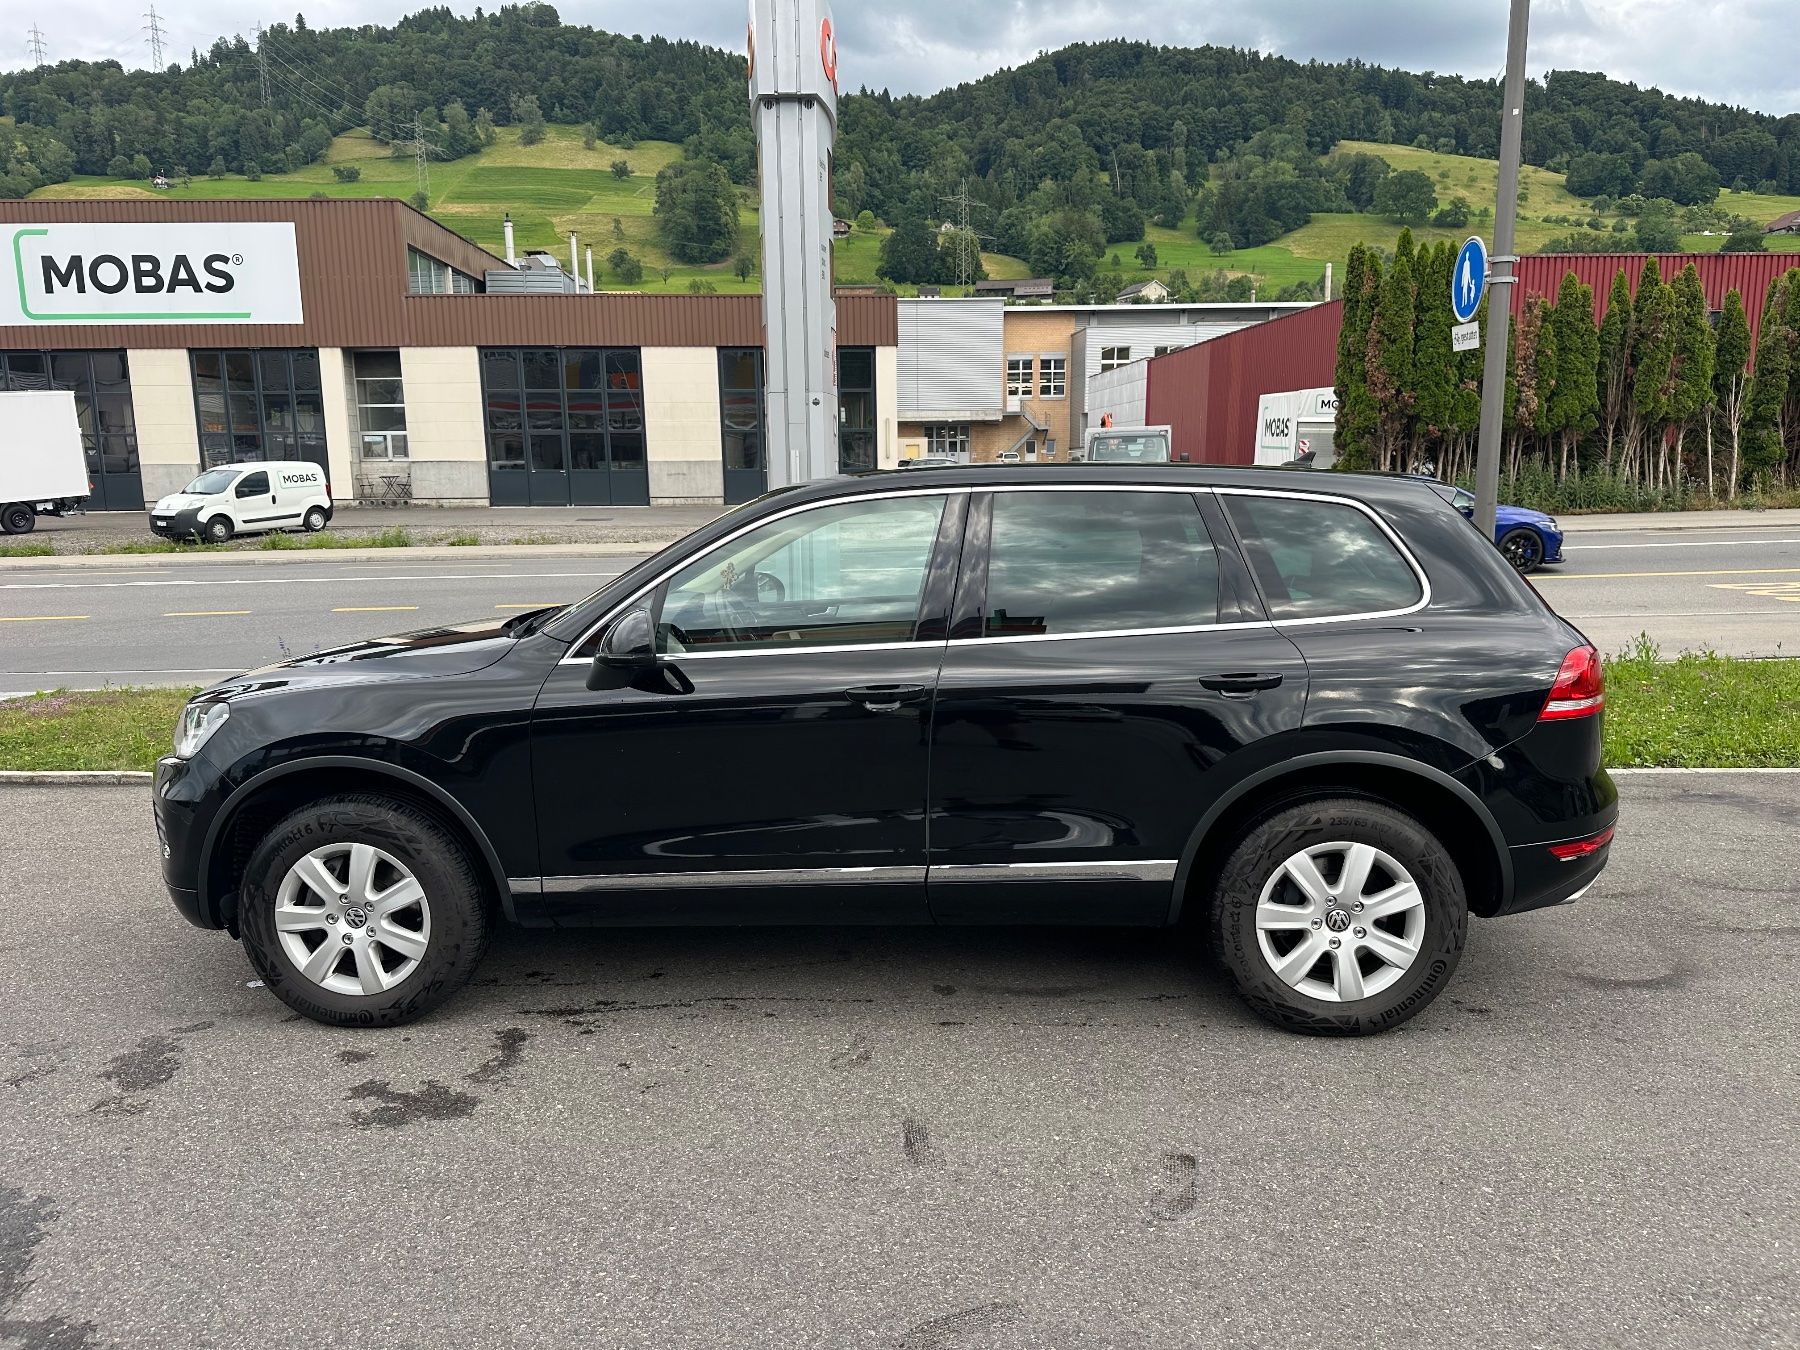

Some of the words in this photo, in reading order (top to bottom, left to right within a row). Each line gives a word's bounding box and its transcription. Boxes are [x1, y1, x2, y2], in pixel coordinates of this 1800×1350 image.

[1264, 418, 1290, 438] MOBAS
[282, 473, 317, 484] MOBAS
[1329, 816, 1368, 828] 235/65
[1380, 960, 1447, 1024] Continental
